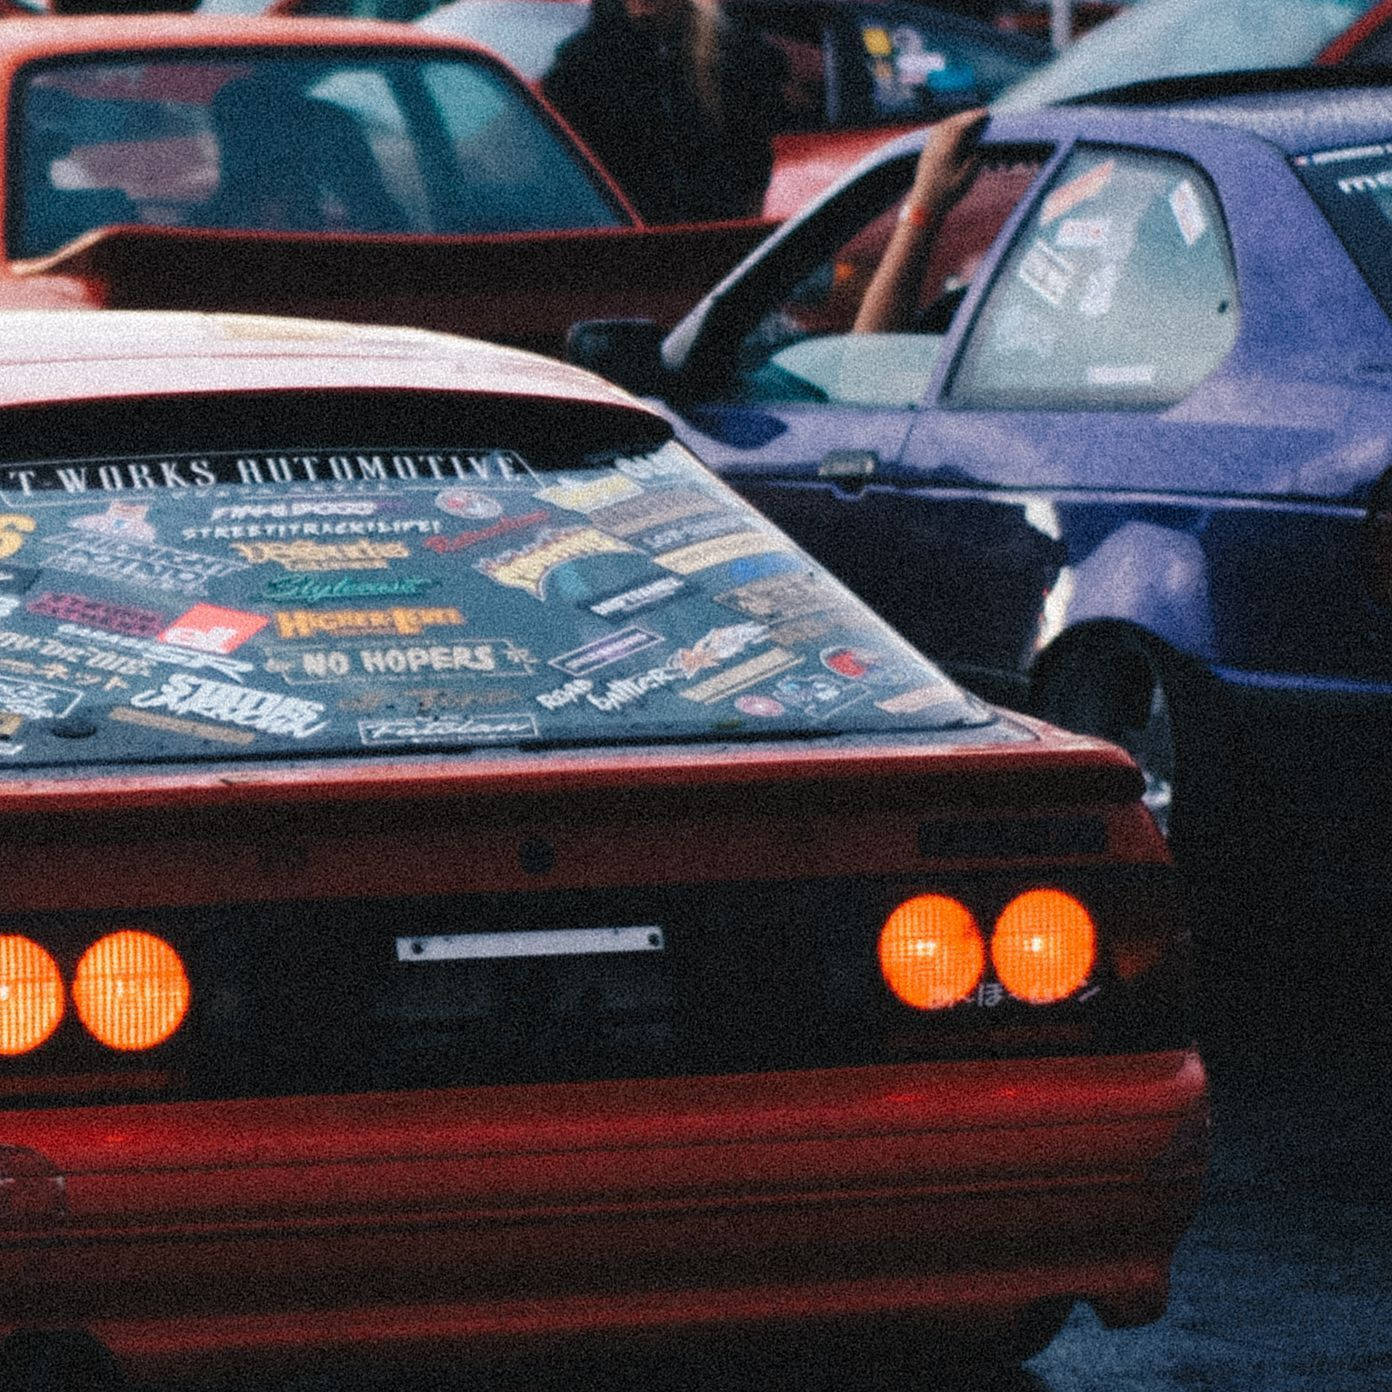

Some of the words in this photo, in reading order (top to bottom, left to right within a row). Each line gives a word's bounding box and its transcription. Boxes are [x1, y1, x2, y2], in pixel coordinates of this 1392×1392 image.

[237, 455, 523, 485] AUTOMOTIVE
[302, 651, 350, 677] NO
[362, 644, 495, 675] HOPERS
